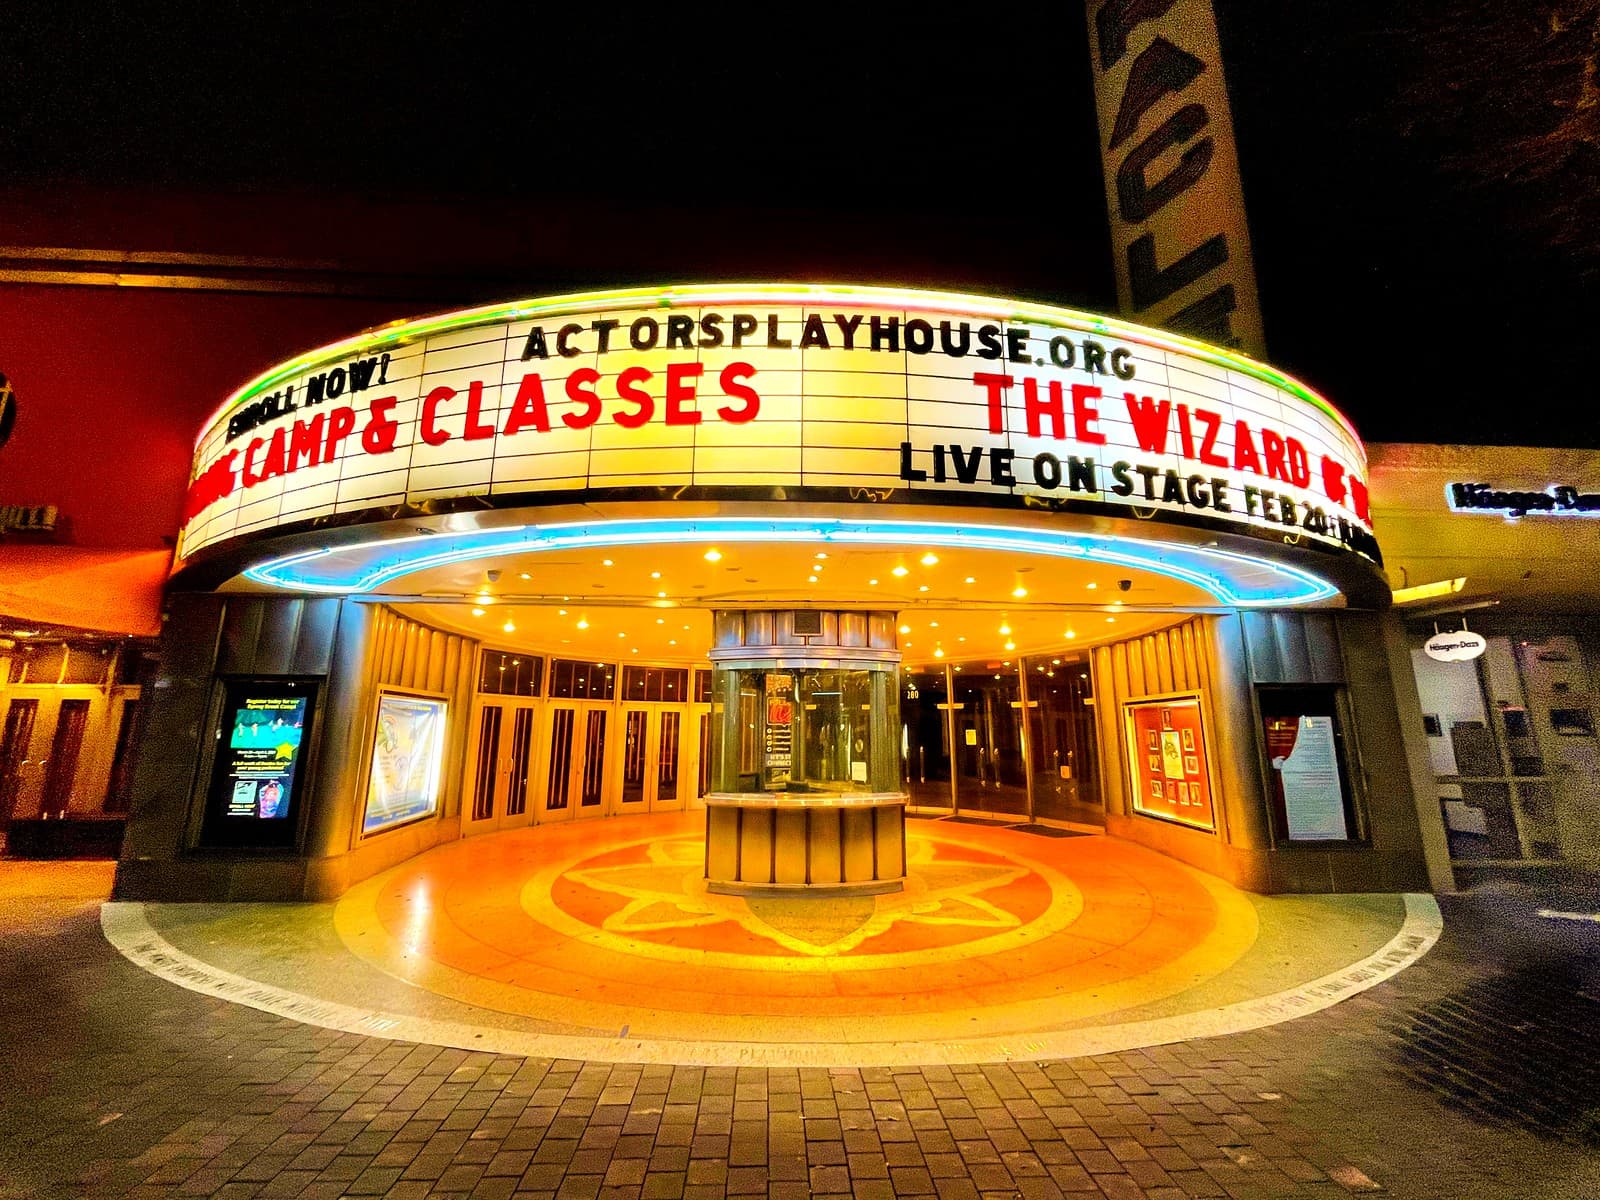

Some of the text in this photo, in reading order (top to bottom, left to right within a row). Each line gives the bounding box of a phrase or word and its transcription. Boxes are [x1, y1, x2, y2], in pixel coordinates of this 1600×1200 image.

[305, 353, 391, 407] NOW!
[521, 312, 1136, 381] ACTORSPLAYHOUSE.ORG
[241, 406, 355, 488] CAMP
[361, 395, 398, 455] &
[420, 361, 761, 446] CLASSES
[973, 372, 1107, 445] THE
[1123, 392, 1311, 489] WIZARD
[900, 442, 1017, 487] LIVE
[1033, 451, 1098, 493] ON
[1111, 460, 1232, 513] STAGE
[1243, 484, 1298, 526] FEB
